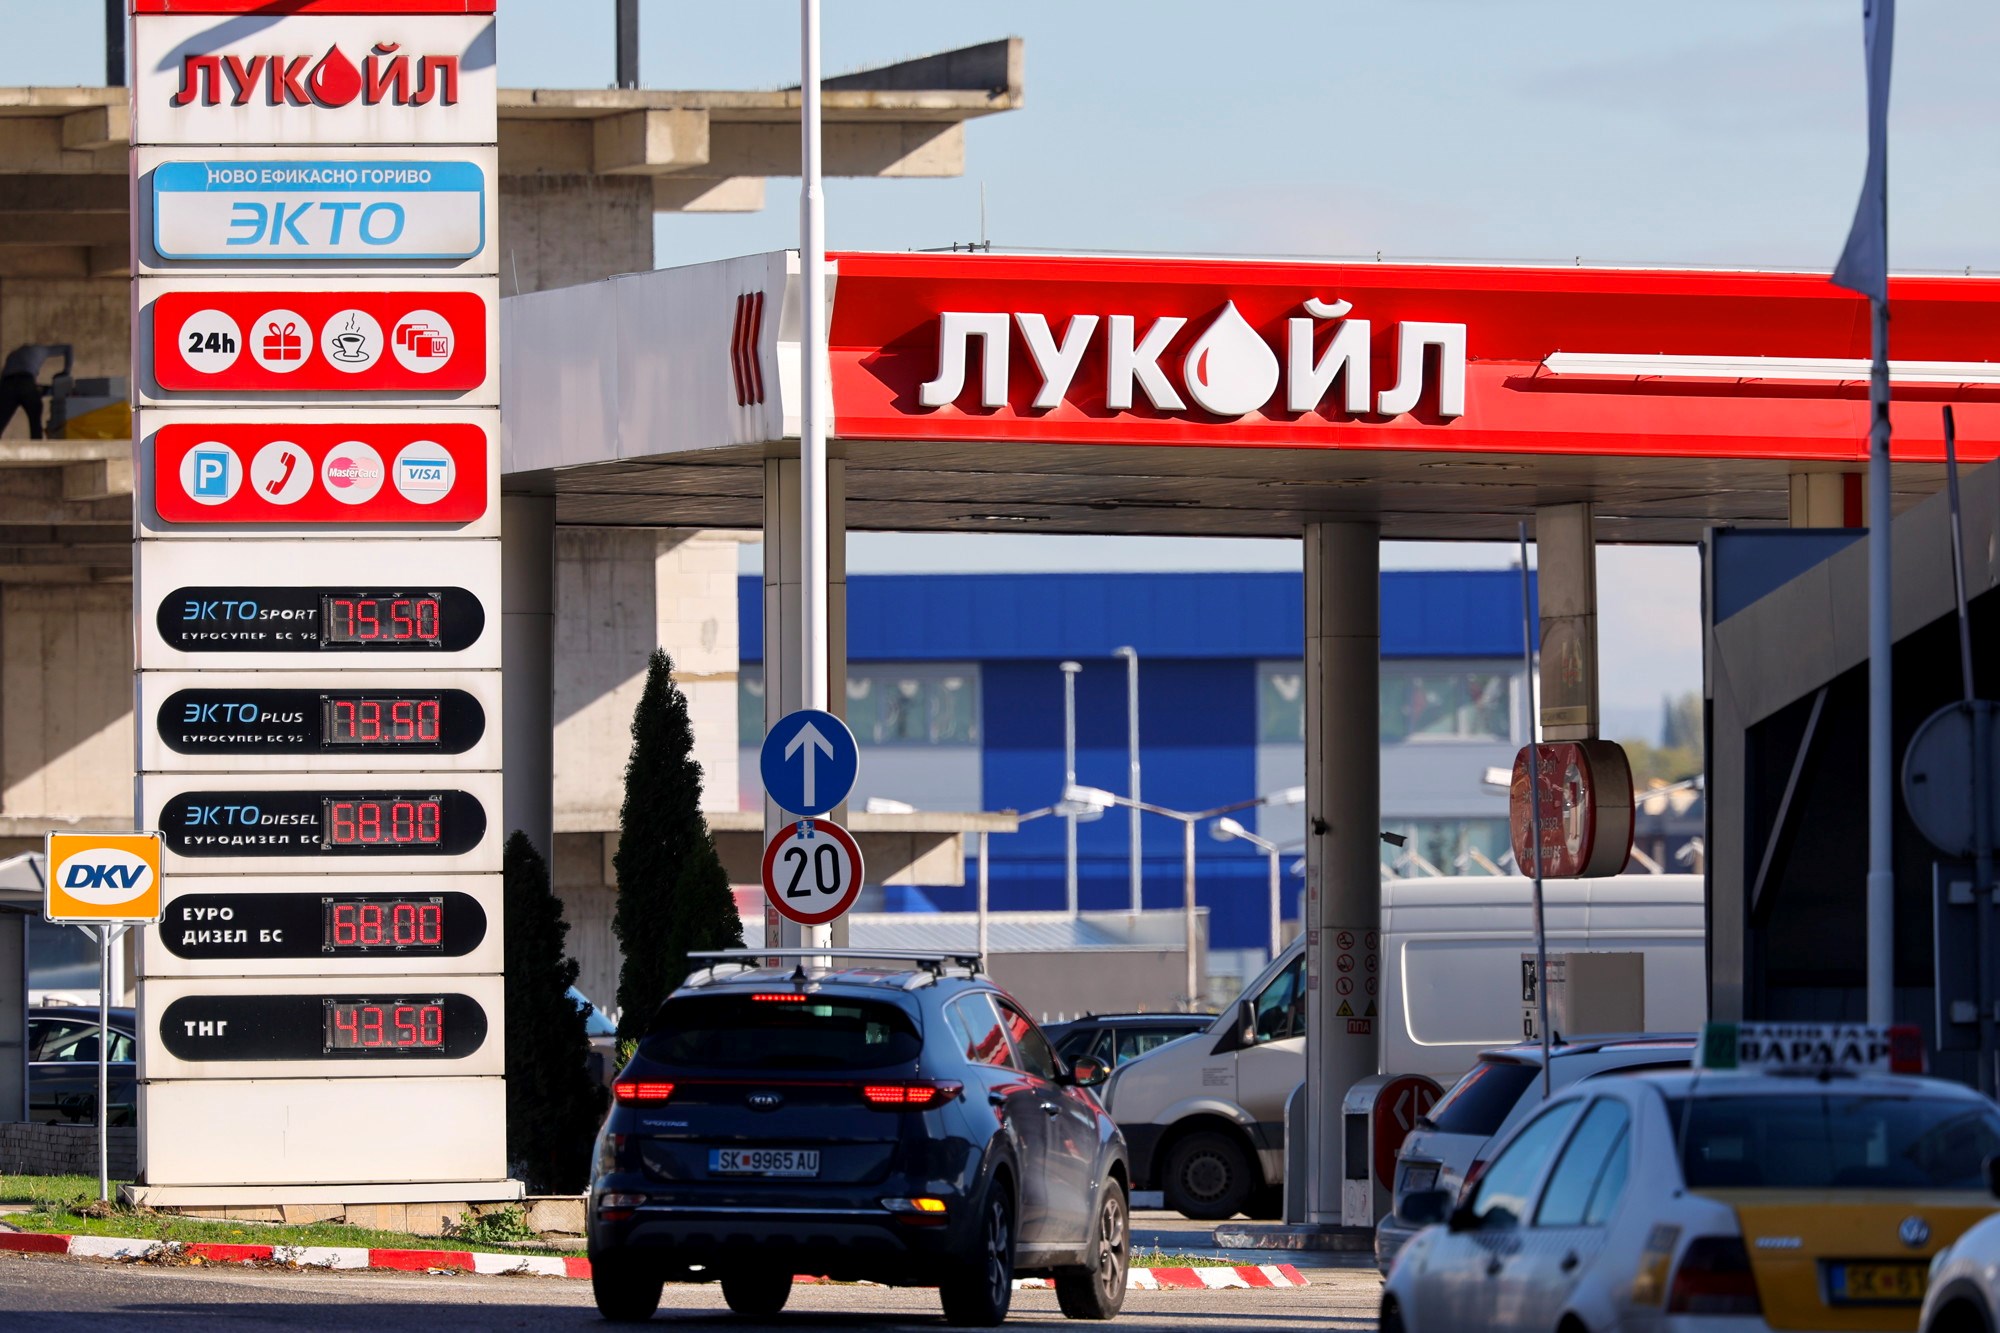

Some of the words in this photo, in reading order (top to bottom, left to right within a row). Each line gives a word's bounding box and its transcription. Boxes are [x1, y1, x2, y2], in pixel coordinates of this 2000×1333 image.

[208, 169, 257, 185] НОВО
[261, 169, 358, 185] ЕФИКАСНО
[361, 169, 431, 185] ГОРИВО
[226, 201, 406, 246] ЭКТО
[188, 331, 235, 354] 24h
[200, 459, 223, 489] P
[328, 467, 378, 480] MasterCard
[407, 468, 441, 481] VISA
[183, 600, 258, 621] ЭКТО
[259, 608, 317, 621] SPORT
[334, 600, 438, 639] 75.50
[181, 632, 268, 641] ЕУРОСУПЕР
[300, 632, 318, 641] 98
[183, 703, 258, 723] ЭКТО
[261, 711, 304, 723] PLUS
[335, 701, 439, 740] 73.50
[182, 735, 263, 743] ЕУРОСУПЕР
[267, 735, 284, 743] БС
[287, 735, 304, 743] 95
[185, 805, 260, 826] ЭКТО
[260, 814, 319, 826] DIESEL
[333, 803, 440, 843] 68.00
[184, 835, 289, 845] ЕУРОДИЗЕЛ
[301, 835, 321, 845] БС
[64, 864, 148, 890] DKV
[784, 843, 841, 898] 20
[183, 907, 234, 921] ЕУРО
[334, 905, 441, 944] 68.00
[182, 930, 248, 945] ДИЗЕЛ
[260, 929, 283, 943] БС
[184, 1020, 228, 1037] ТНГ
[336, 1006, 443, 1046] 43.50
[1349, 1020, 1370, 1033] ППА
[754, 1096, 773, 1105] KIA
[720, 1151, 740, 1169] SK
[752, 1151, 793, 1170] 9965
[796, 1152, 818, 1170] AU
